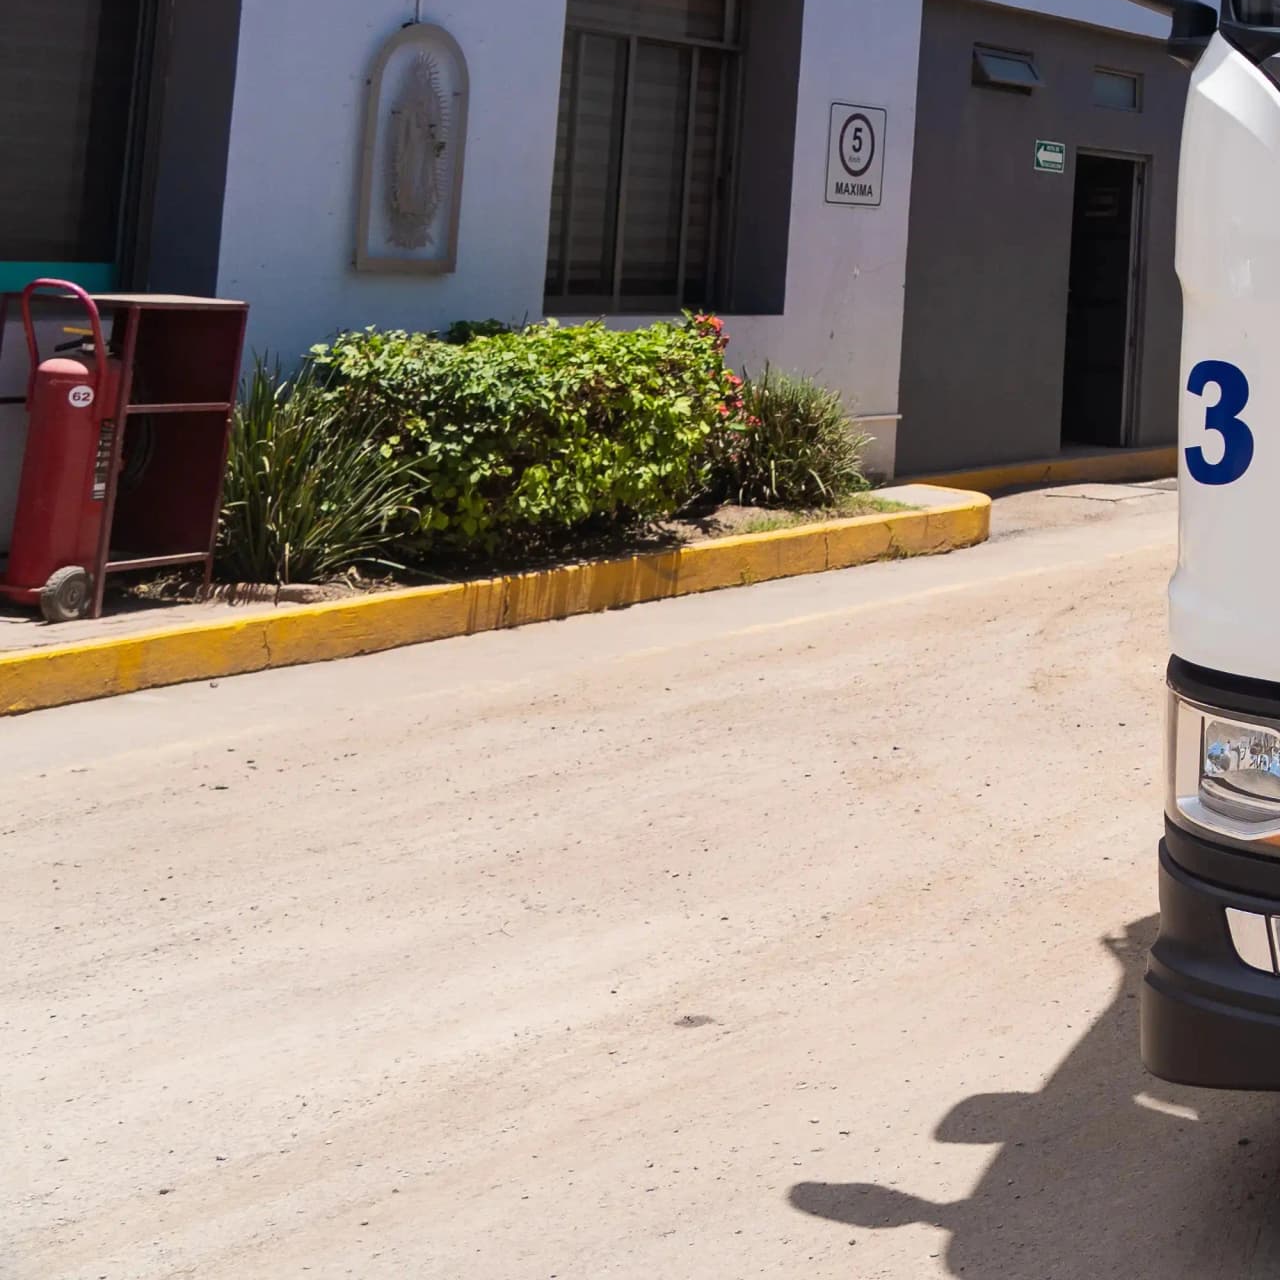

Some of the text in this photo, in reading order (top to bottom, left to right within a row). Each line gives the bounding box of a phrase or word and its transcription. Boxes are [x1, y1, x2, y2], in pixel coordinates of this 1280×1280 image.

[851, 127, 863, 153] 5
[834, 181, 874, 197] MAXIMA
[72, 391, 91, 402] 62
[1184, 359, 1255, 486] 3
